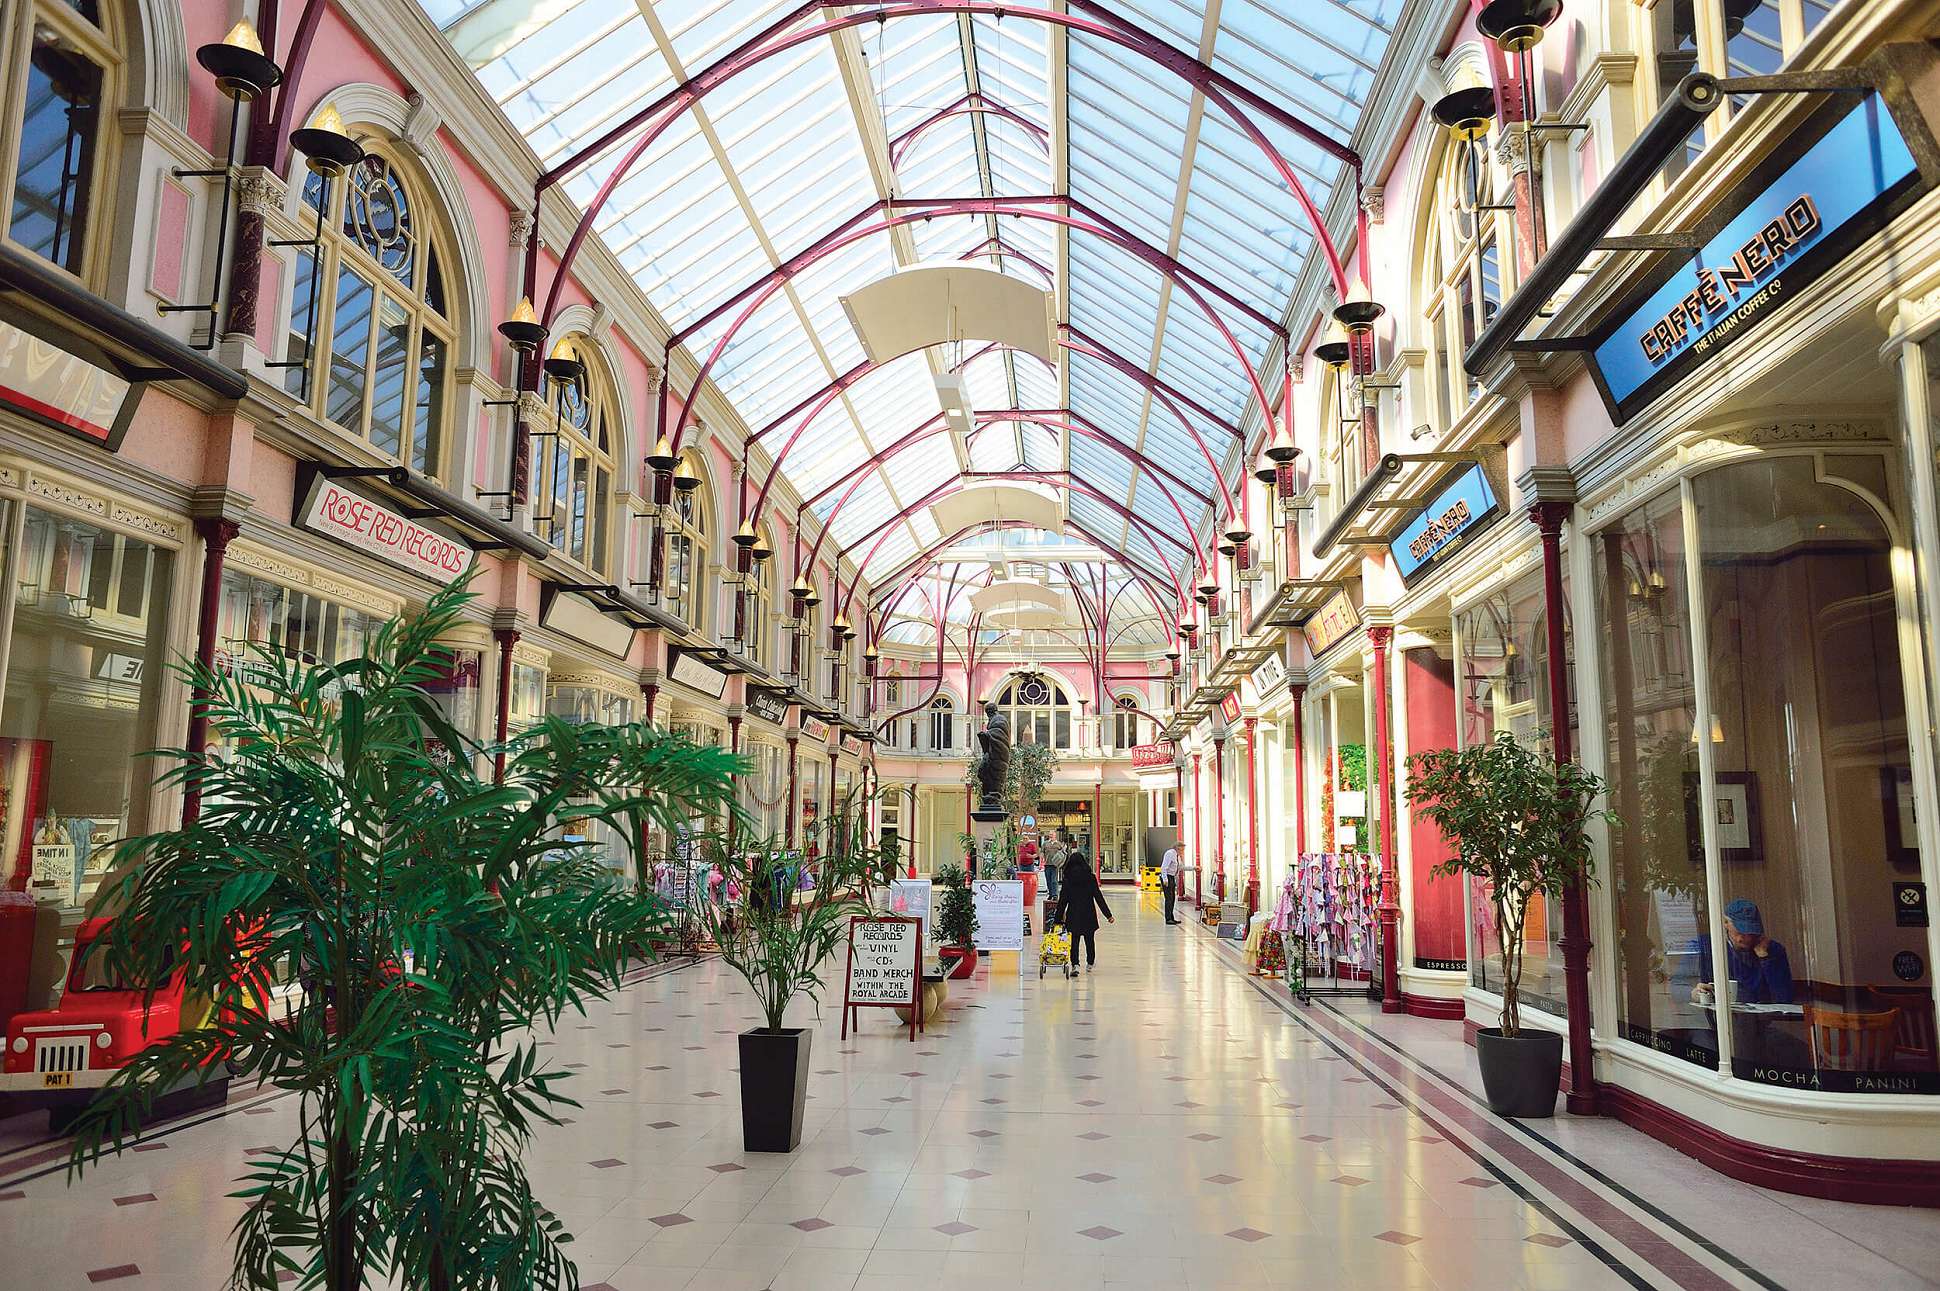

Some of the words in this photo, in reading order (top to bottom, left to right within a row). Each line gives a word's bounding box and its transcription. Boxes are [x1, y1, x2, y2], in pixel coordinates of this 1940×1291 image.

[1717, 194, 1820, 296] NERO
[1693, 337, 1710, 354] THE
[1707, 314, 1739, 344] ITALIAN
[1737, 290, 1770, 320] COFFEE
[1437, 497, 1471, 537] NERO
[319, 488, 374, 533] ROSE
[368, 511, 403, 546] RED
[399, 526, 466, 574] RECORDS
[860, 923, 885, 932] ROSE
[889, 923, 907, 932] RED
[863, 932, 903, 941] RECORDS
[869, 944, 898, 953] VINYL
[1426, 961, 1467, 970] ESPRESSO
[853, 968, 878, 978] BAND
[883, 968, 913, 978] MERCH
[857, 981, 884, 990] WITHIN
[889, 982, 905, 990] THE
[852, 989, 877, 998] ROYAL
[879, 990, 909, 999] ARCADE
[1630, 1028, 1672, 1051] CAPPUCCINO
[1686, 1047, 1706, 1063] LATTE
[46, 1074, 63, 1085] PAT
[1754, 1067, 1821, 1086] MOCHA
[1855, 1076, 1917, 1090] PANINI
